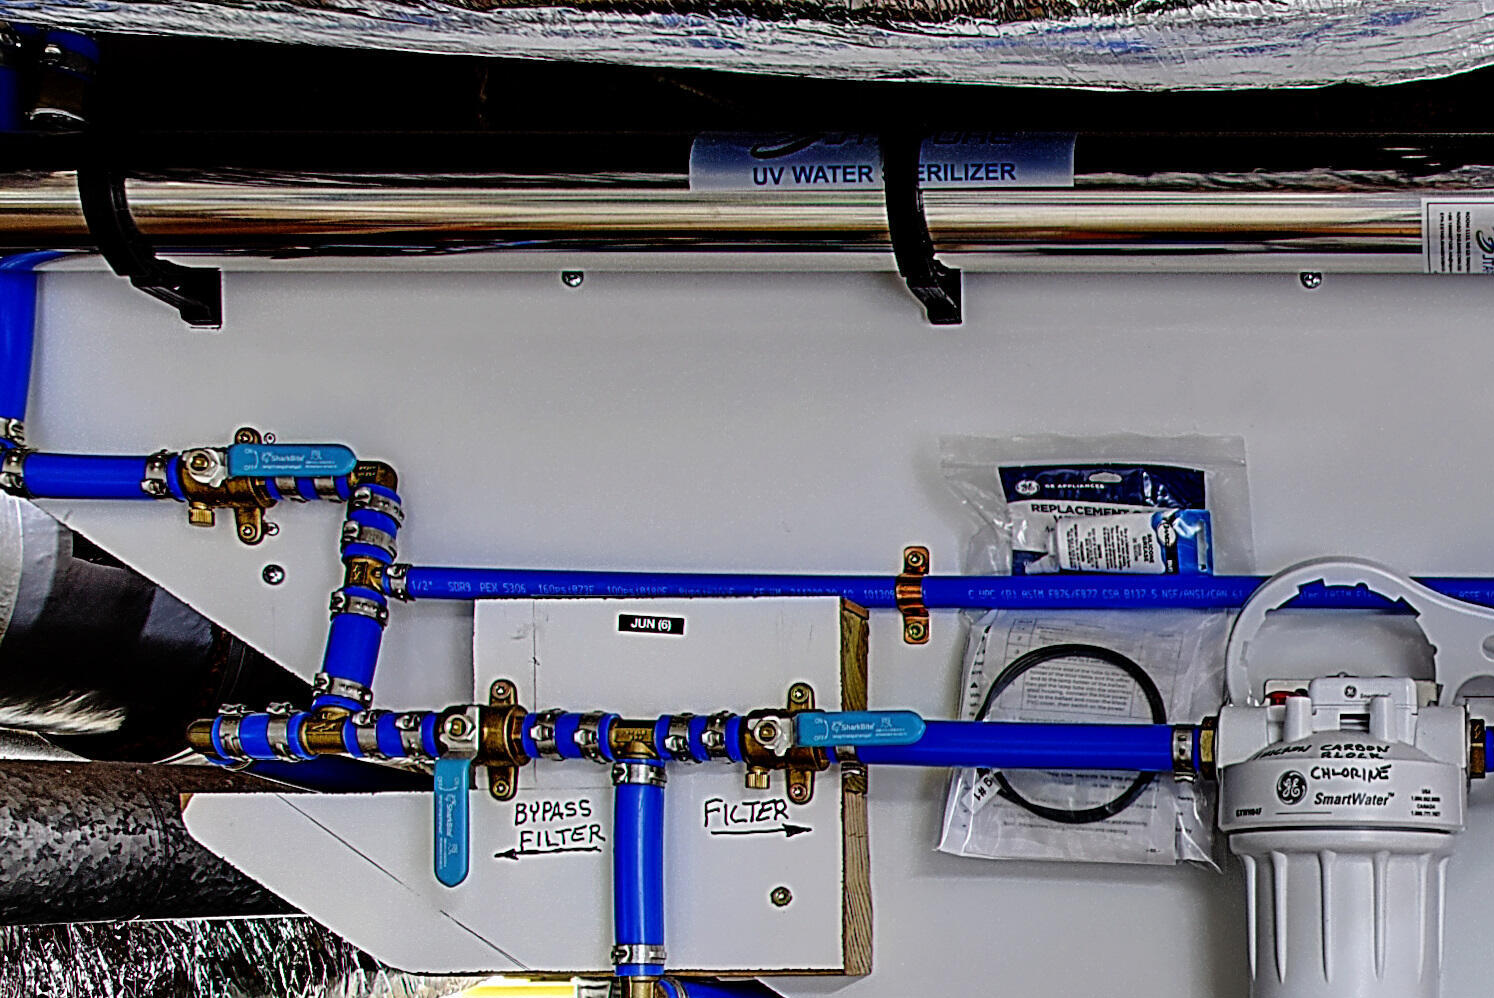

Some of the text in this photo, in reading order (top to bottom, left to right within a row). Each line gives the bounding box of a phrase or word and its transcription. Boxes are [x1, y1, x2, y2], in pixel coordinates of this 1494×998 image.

[753, 167, 786, 185] UV
[792, 165, 874, 184] WATER
[1031, 504, 1129, 515] REPLACEMENT
[479, 582, 498, 592] PEX
[630, 617, 672, 632] JUN (6)
[1320, 744, 1390, 752] CARBON
[1310, 764, 1392, 782] CHLORINE
[514, 799, 593, 827] BYPASS
[704, 797, 790, 828] FILTER
[520, 824, 606, 851] FILTER
